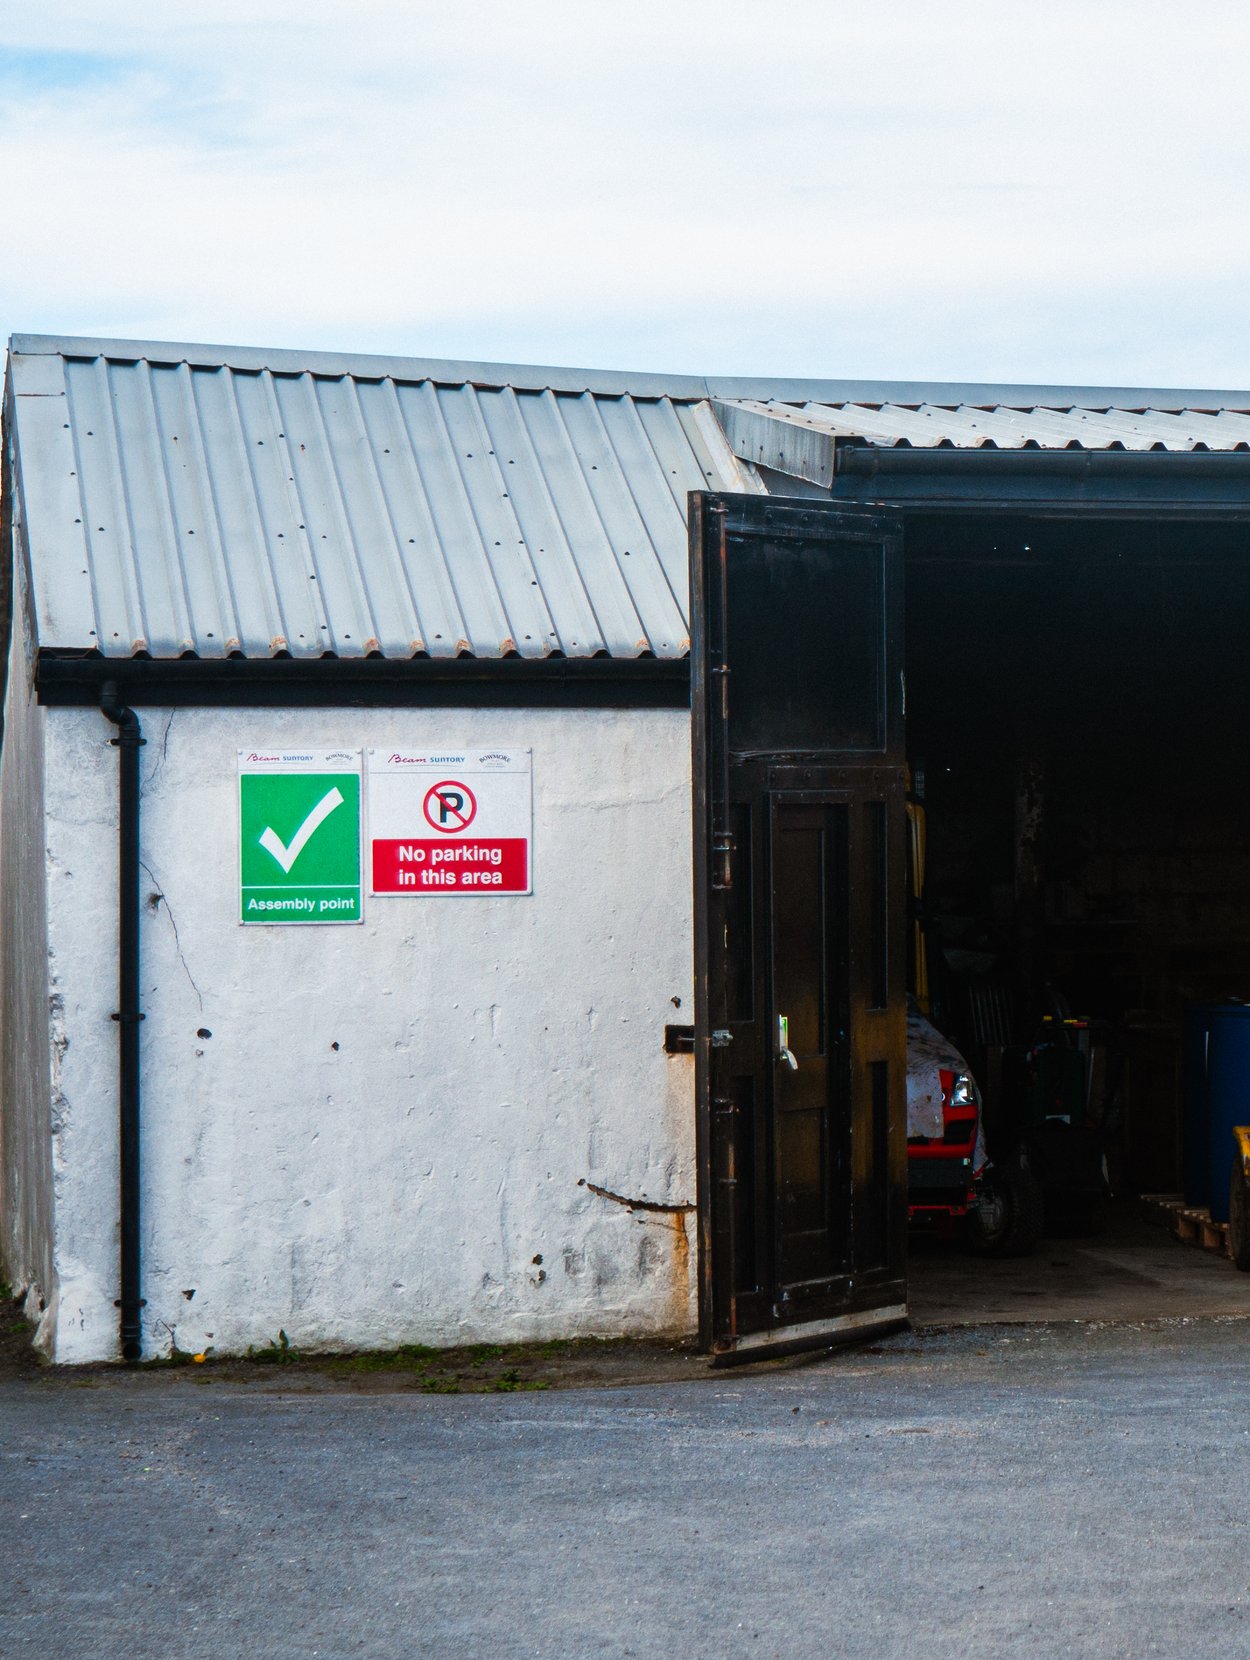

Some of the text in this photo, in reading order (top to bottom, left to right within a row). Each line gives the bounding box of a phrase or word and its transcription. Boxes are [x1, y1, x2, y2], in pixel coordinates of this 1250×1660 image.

[246, 753, 280, 762] Beam
[387, 753, 426, 763] Beam
[479, 754, 511, 763] BOWMORE
[399, 845, 502, 866] No parking
[398, 868, 503, 885] in this area
[247, 897, 355, 912] Assembly point
